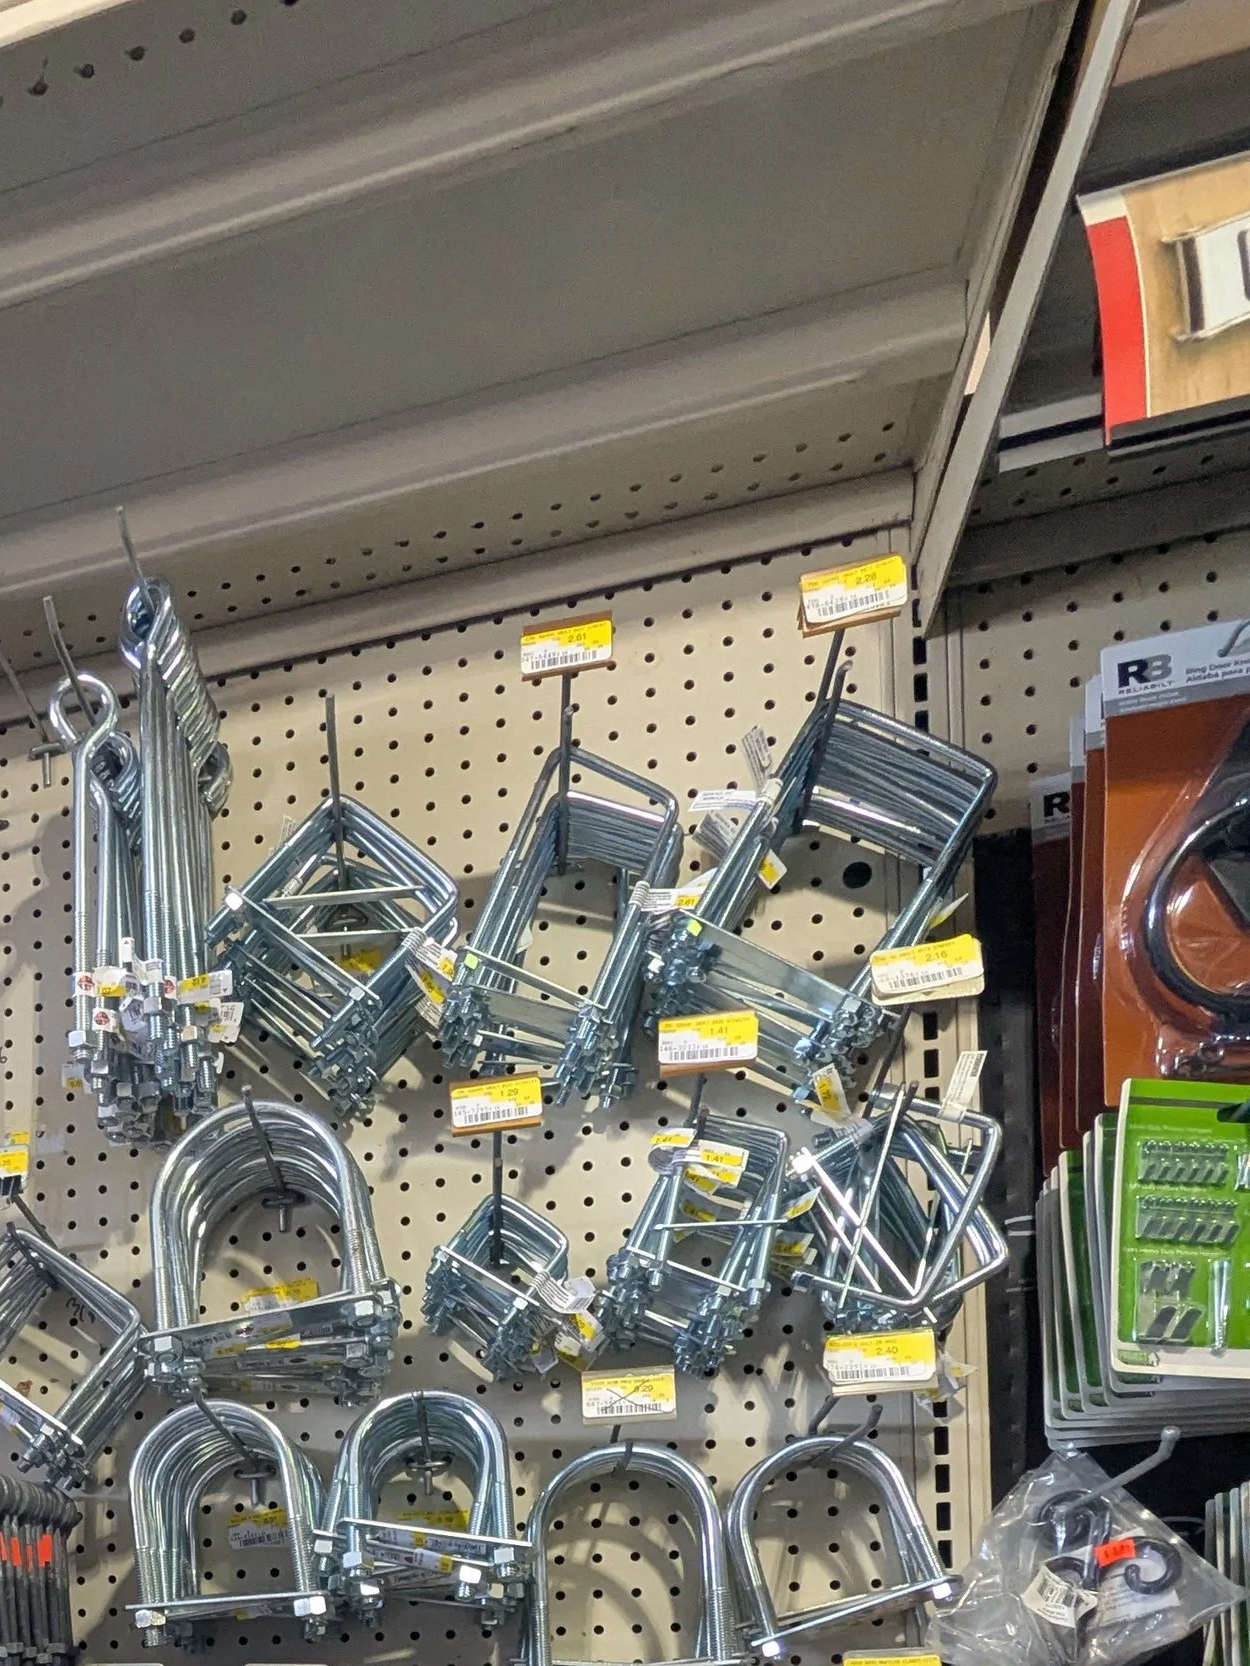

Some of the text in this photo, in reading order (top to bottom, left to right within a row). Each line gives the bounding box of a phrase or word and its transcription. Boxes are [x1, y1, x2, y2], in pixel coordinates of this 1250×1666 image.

[1117, 653, 1173, 689] RB
[710, 1027, 729, 1036] 1.41
[706, 1155, 724, 1164] 1.41
[876, 1347, 899, 1356] 2.40
